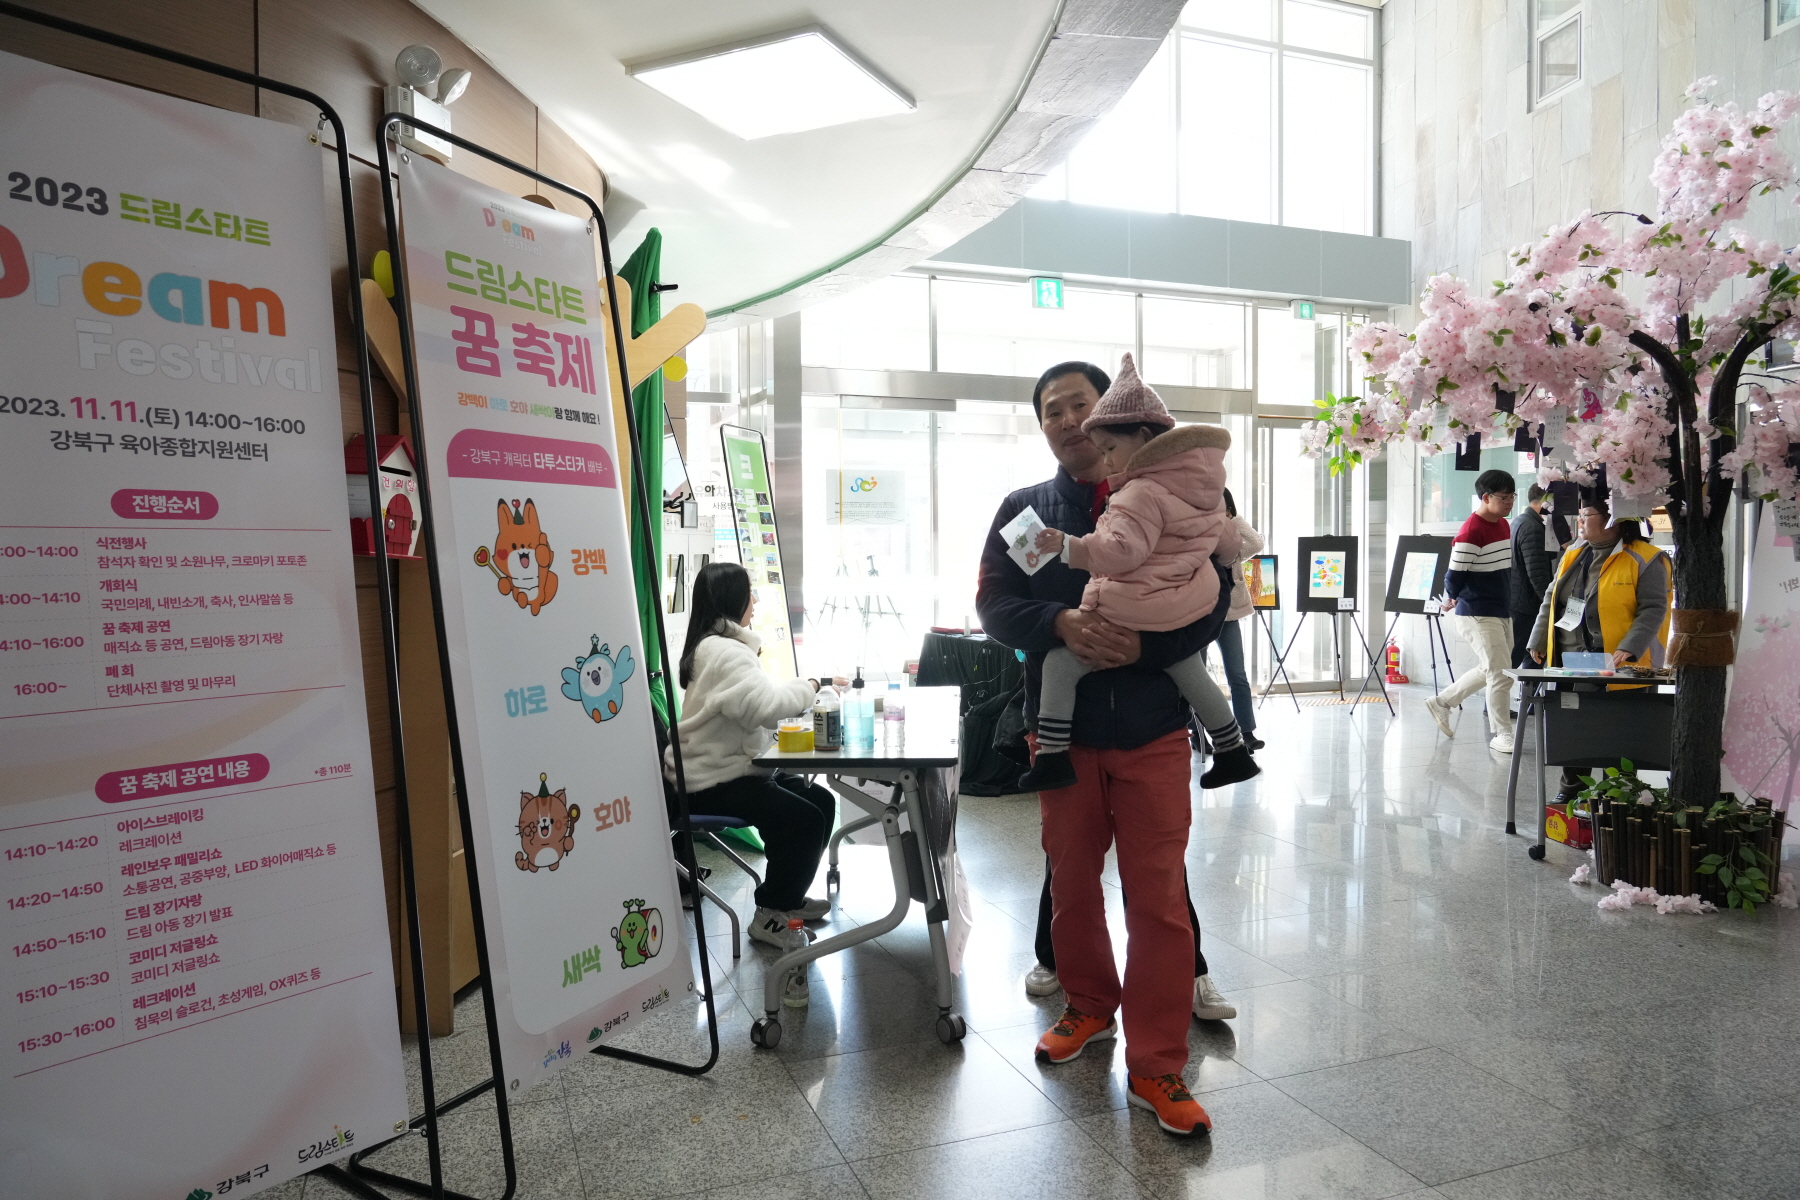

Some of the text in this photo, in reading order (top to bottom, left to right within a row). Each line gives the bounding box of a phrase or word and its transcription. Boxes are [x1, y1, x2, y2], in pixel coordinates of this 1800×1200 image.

[8, 171, 271, 246] 2023 드림스타트
[482, 207, 535, 242] Deam
[444, 250, 588, 326] 드림스타트
[75, 318, 322, 393] Festival
[450, 304, 597, 396] 꿈 축제
[457, 392, 488, 409] 강백이
[510, 400, 528, 415] 호야
[184, 411, 306, 435] 14:00~16:00
[50, 430, 269, 462] 강북구 육아종합지원센터
[470, 448, 502, 466] 강북구
[503, 451, 532, 468] 캐릭터
[533, 452, 586, 473] 타투스티커
[131, 494, 201, 514] 진행순서
[95, 537, 147, 550] 식전행사
[97, 554, 308, 569] 참석자 확인 및 소원나무, 크로마키 포토존
[571, 547, 608, 576] 강백
[99, 578, 138, 593] 개회식
[100, 592, 294, 612] 국민의례, 내빈소개, 축사, 인사말씀 등
[102, 619, 171, 635] 꿈 축제 공연
[104, 632, 284, 655] 매직쇼 등 공연, 드림아동 장기 자랑
[14, 681, 67, 696] 16:00~
[107, 674, 236, 698] 단체사진 촬영 및 마무리
[504, 683, 548, 718] 하로
[119, 760, 250, 795] 꿈 축제 공연 내용
[329, 763, 352, 775] 110분
[116, 808, 205, 834] 아이스브레이킹
[593, 795, 632, 833] 호야
[4, 834, 99, 862] 14:10~14:20
[118, 831, 182, 853] 레크레이션
[121, 847, 223, 878] 레인보우 패밀리쇼
[122, 843, 337, 897] 소통공연, 공중부양, LED 화이어매직쇼 등
[7, 881, 104, 912] 14:20~14:50
[124, 893, 203, 921] 드림 장기자랑
[126, 906, 234, 941] 드림 아동 장기 발표
[13, 926, 107, 959] 14:50~15:10
[128, 933, 219, 965] 코미디 저글링쇼
[130, 952, 221, 985] 코미디 저글링쇼
[561, 943, 602, 992] 새싹
[16, 971, 110, 1005] 15:10~15:30
[132, 982, 196, 1010] 레크레이션
[134, 967, 322, 1031] 침묵의 슬로건, 초성게임, OX퀴즈 등
[18, 1016, 116, 1053] 15:30~16:00
[603, 1011, 630, 1033] 강북구
[216, 1164, 269, 1195] 강북구
